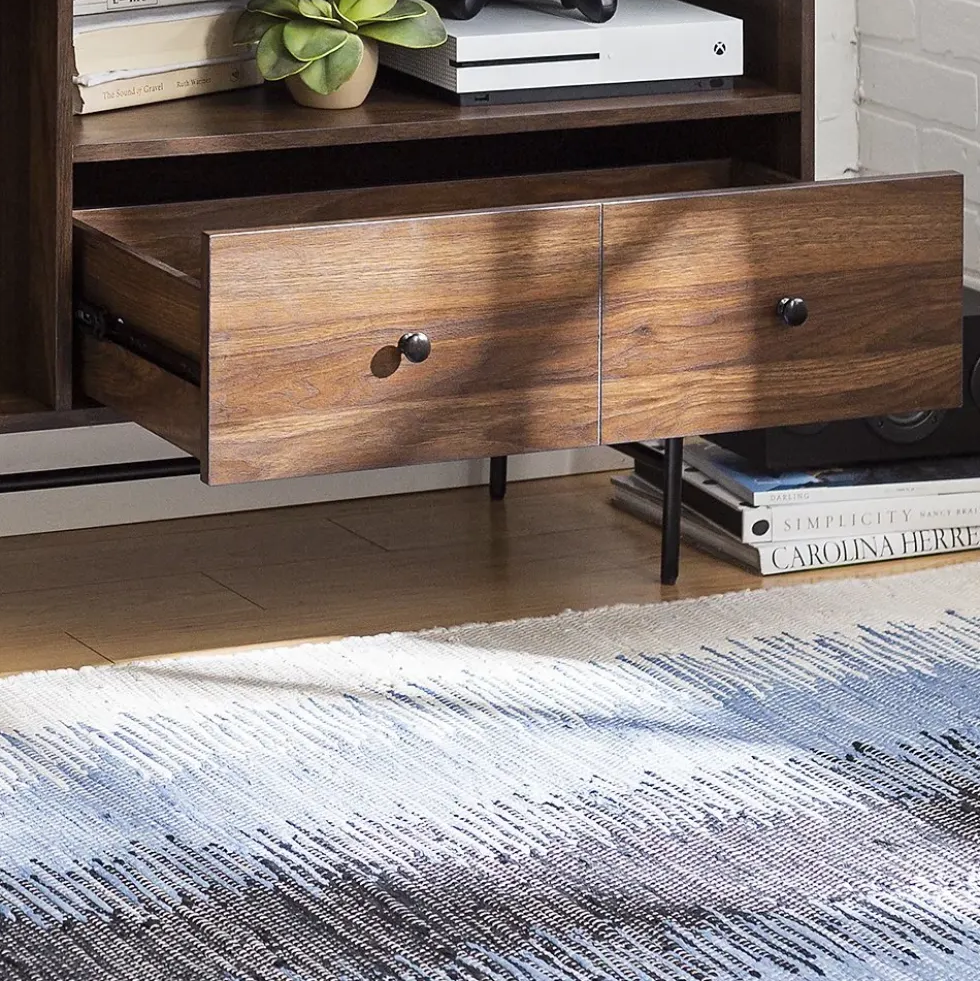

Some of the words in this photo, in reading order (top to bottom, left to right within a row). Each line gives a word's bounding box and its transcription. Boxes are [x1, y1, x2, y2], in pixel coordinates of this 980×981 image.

[102, 90, 116, 100] The
[116, 87, 136, 97] Sound
[143, 82, 164, 94] Gravel
[770, 492, 810, 502] DARLING
[783, 508, 912, 532] SIMPLICITY
[771, 534, 895, 570] CAROLINA
